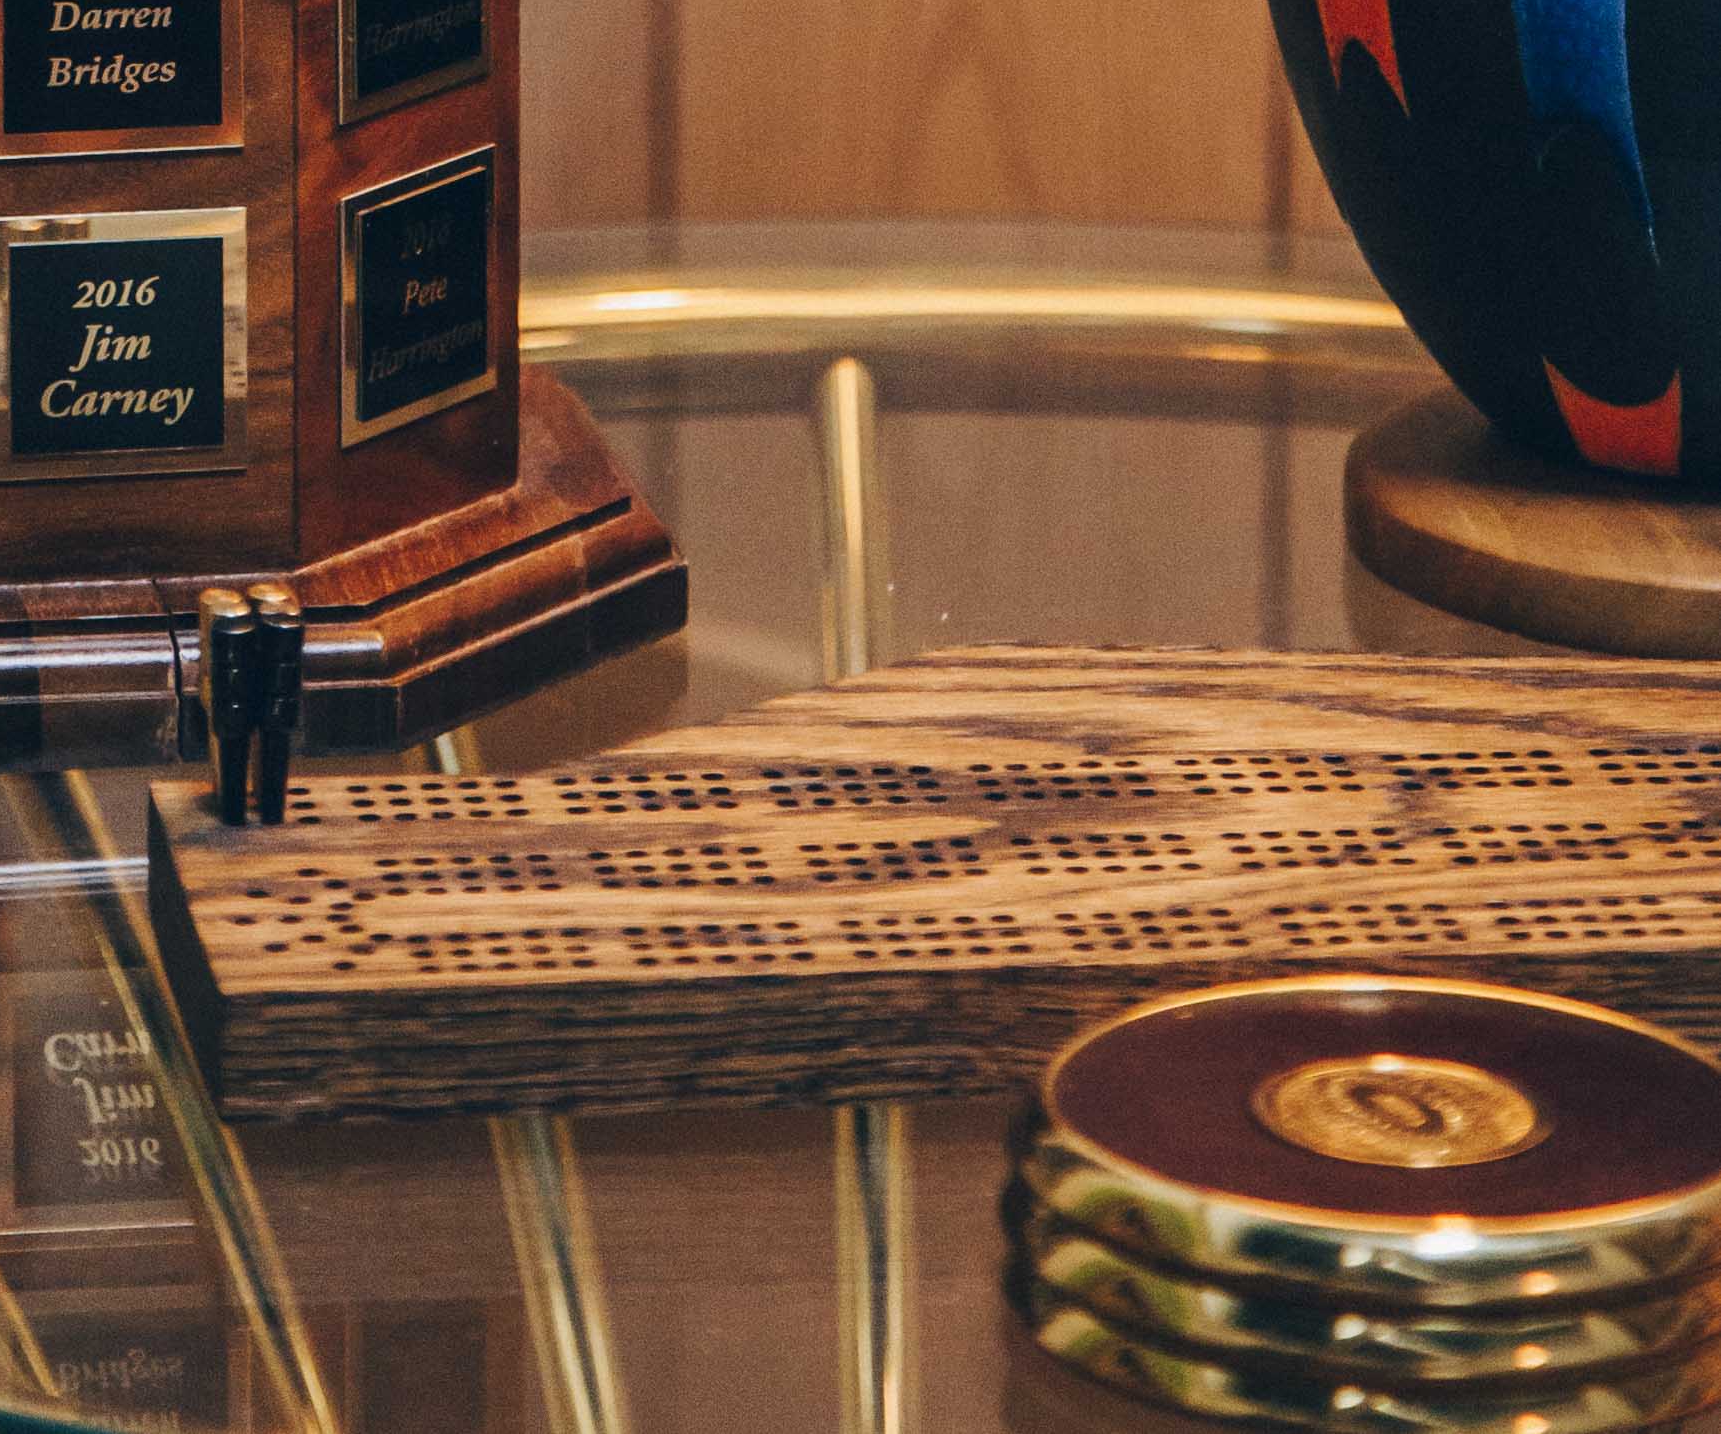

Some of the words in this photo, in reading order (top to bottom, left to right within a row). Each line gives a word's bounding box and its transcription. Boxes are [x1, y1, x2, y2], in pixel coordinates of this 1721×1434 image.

[49, 0, 173, 32] Darren
[46, 53, 177, 94] Bridges
[71, 275, 160, 309] 2016
[402, 275, 449, 316] Pete
[68, 323, 152, 373] Jim
[39, 379, 194, 426] Carney
